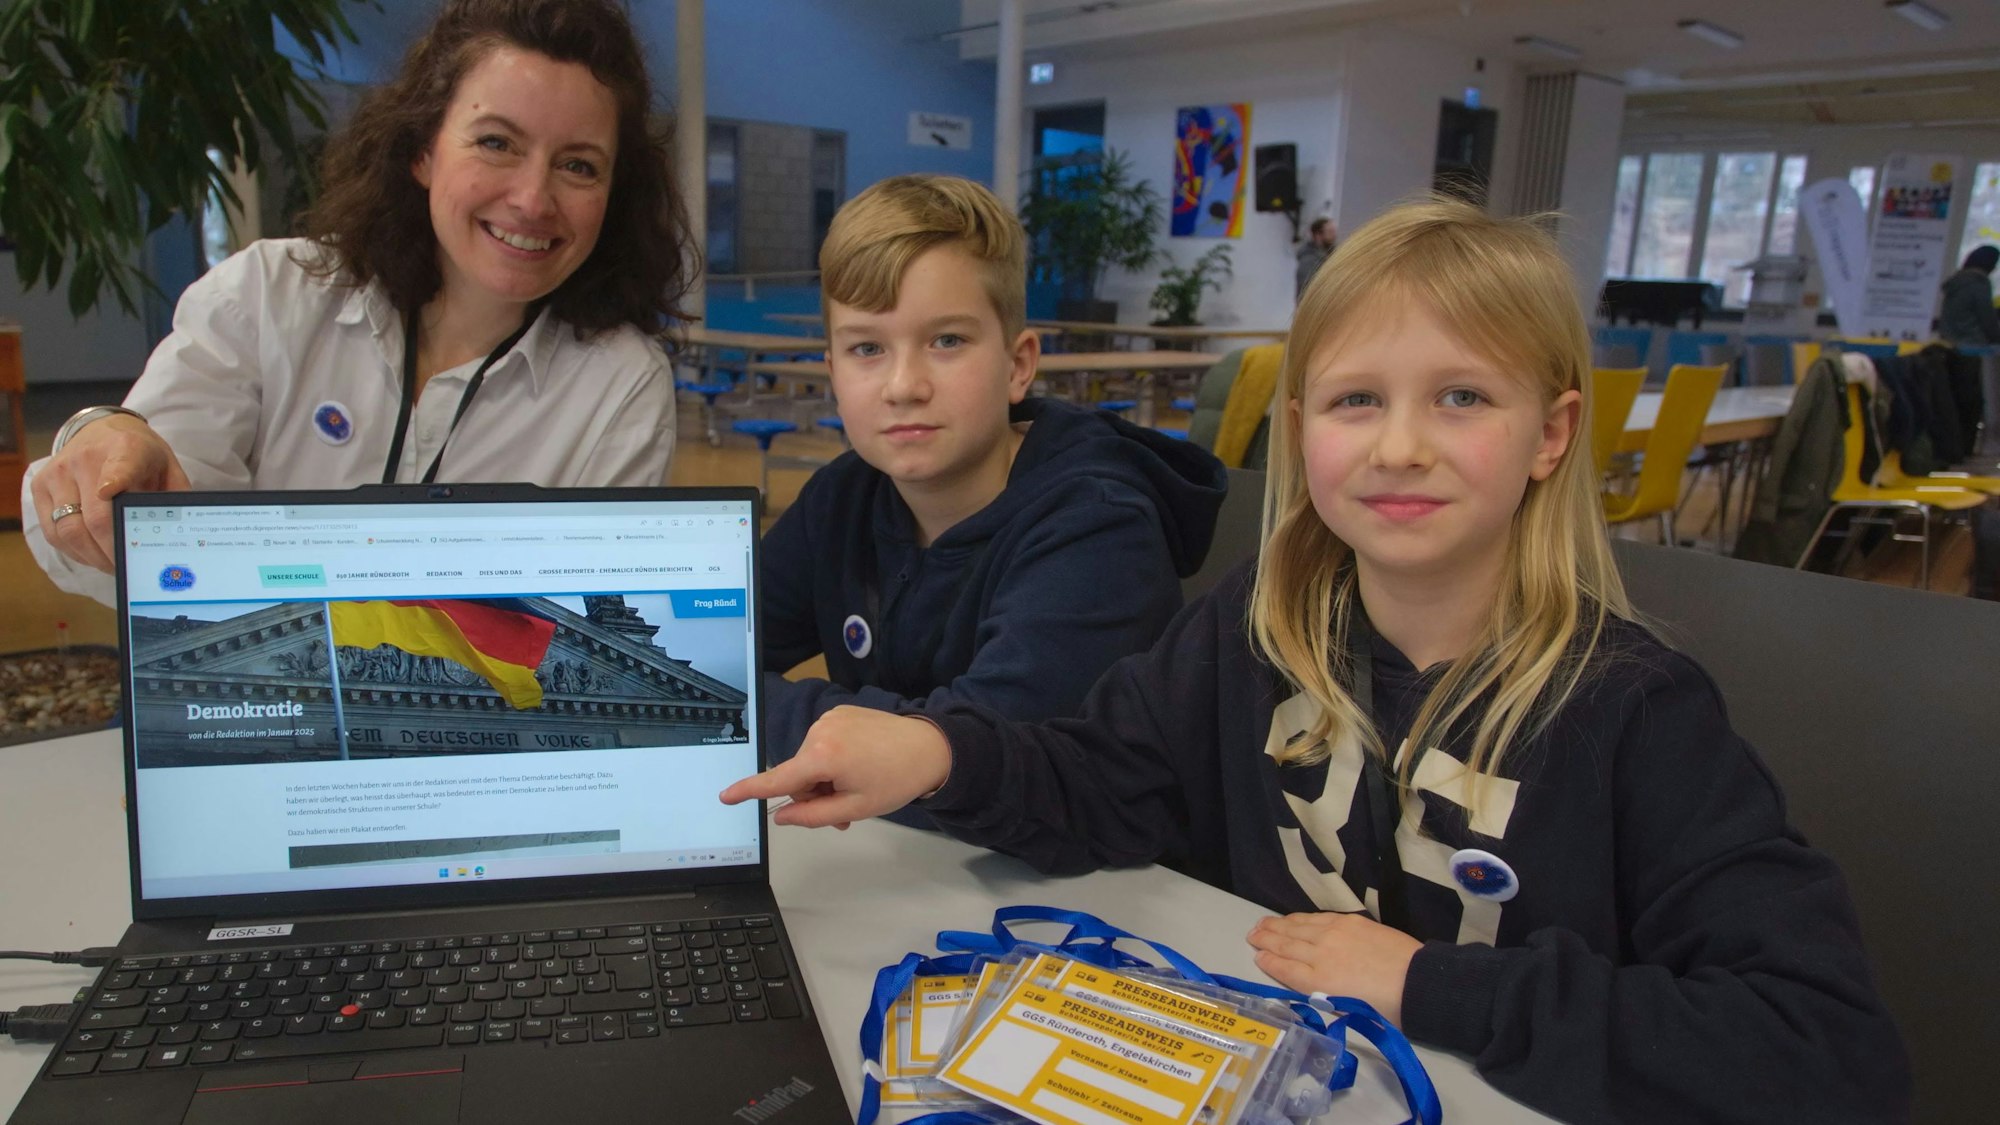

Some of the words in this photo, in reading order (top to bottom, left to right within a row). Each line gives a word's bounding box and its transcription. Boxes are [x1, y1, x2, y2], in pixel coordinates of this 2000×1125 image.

[694, 599, 712, 608] Frag
[714, 598, 737, 607] Ründi
[187, 700, 303, 720] Demokratie
[204, 731, 215, 739] die
[216, 729, 255, 738] Redaktion
[256, 728, 266, 737] im
[267, 728, 294, 738] Januar
[294, 728, 314, 736] 2025
[402, 730, 519, 746] DEUTSCHEN
[534, 734, 592, 748] VOLKE
[298, 808, 347, 816] demokratische
[216, 926, 285, 938] GGSR-SL
[928, 992, 951, 1001] GGS
[1076, 991, 1098, 1004] GGS
[1113, 980, 1237, 1026] PRESSEAUSWEIS
[1062, 1000, 1184, 1050] PRESSEAUSWEIS
[1112, 990, 1192, 1021] Schülerreporter/in
[1195, 1018, 1229, 1033] der/des
[1022, 1010, 1046, 1024] GGS
[1047, 1018, 1108, 1048] Ründeroth,
[1110, 1042, 1192, 1079] Engelskirchen
[1058, 1009, 1139, 1044] Schülerreporter/in
[1141, 1039, 1176, 1056] der/des
[1070, 1049, 1109, 1069] Vorname
[1110, 1062, 1118, 1072] /
[1118, 1066, 1148, 1084] Klasse
[732, 1076, 815, 1125] ThinkPad
[1047, 1079, 1090, 1102] Schuljahr
[1101, 1100, 1144, 1123] Zeitraum
